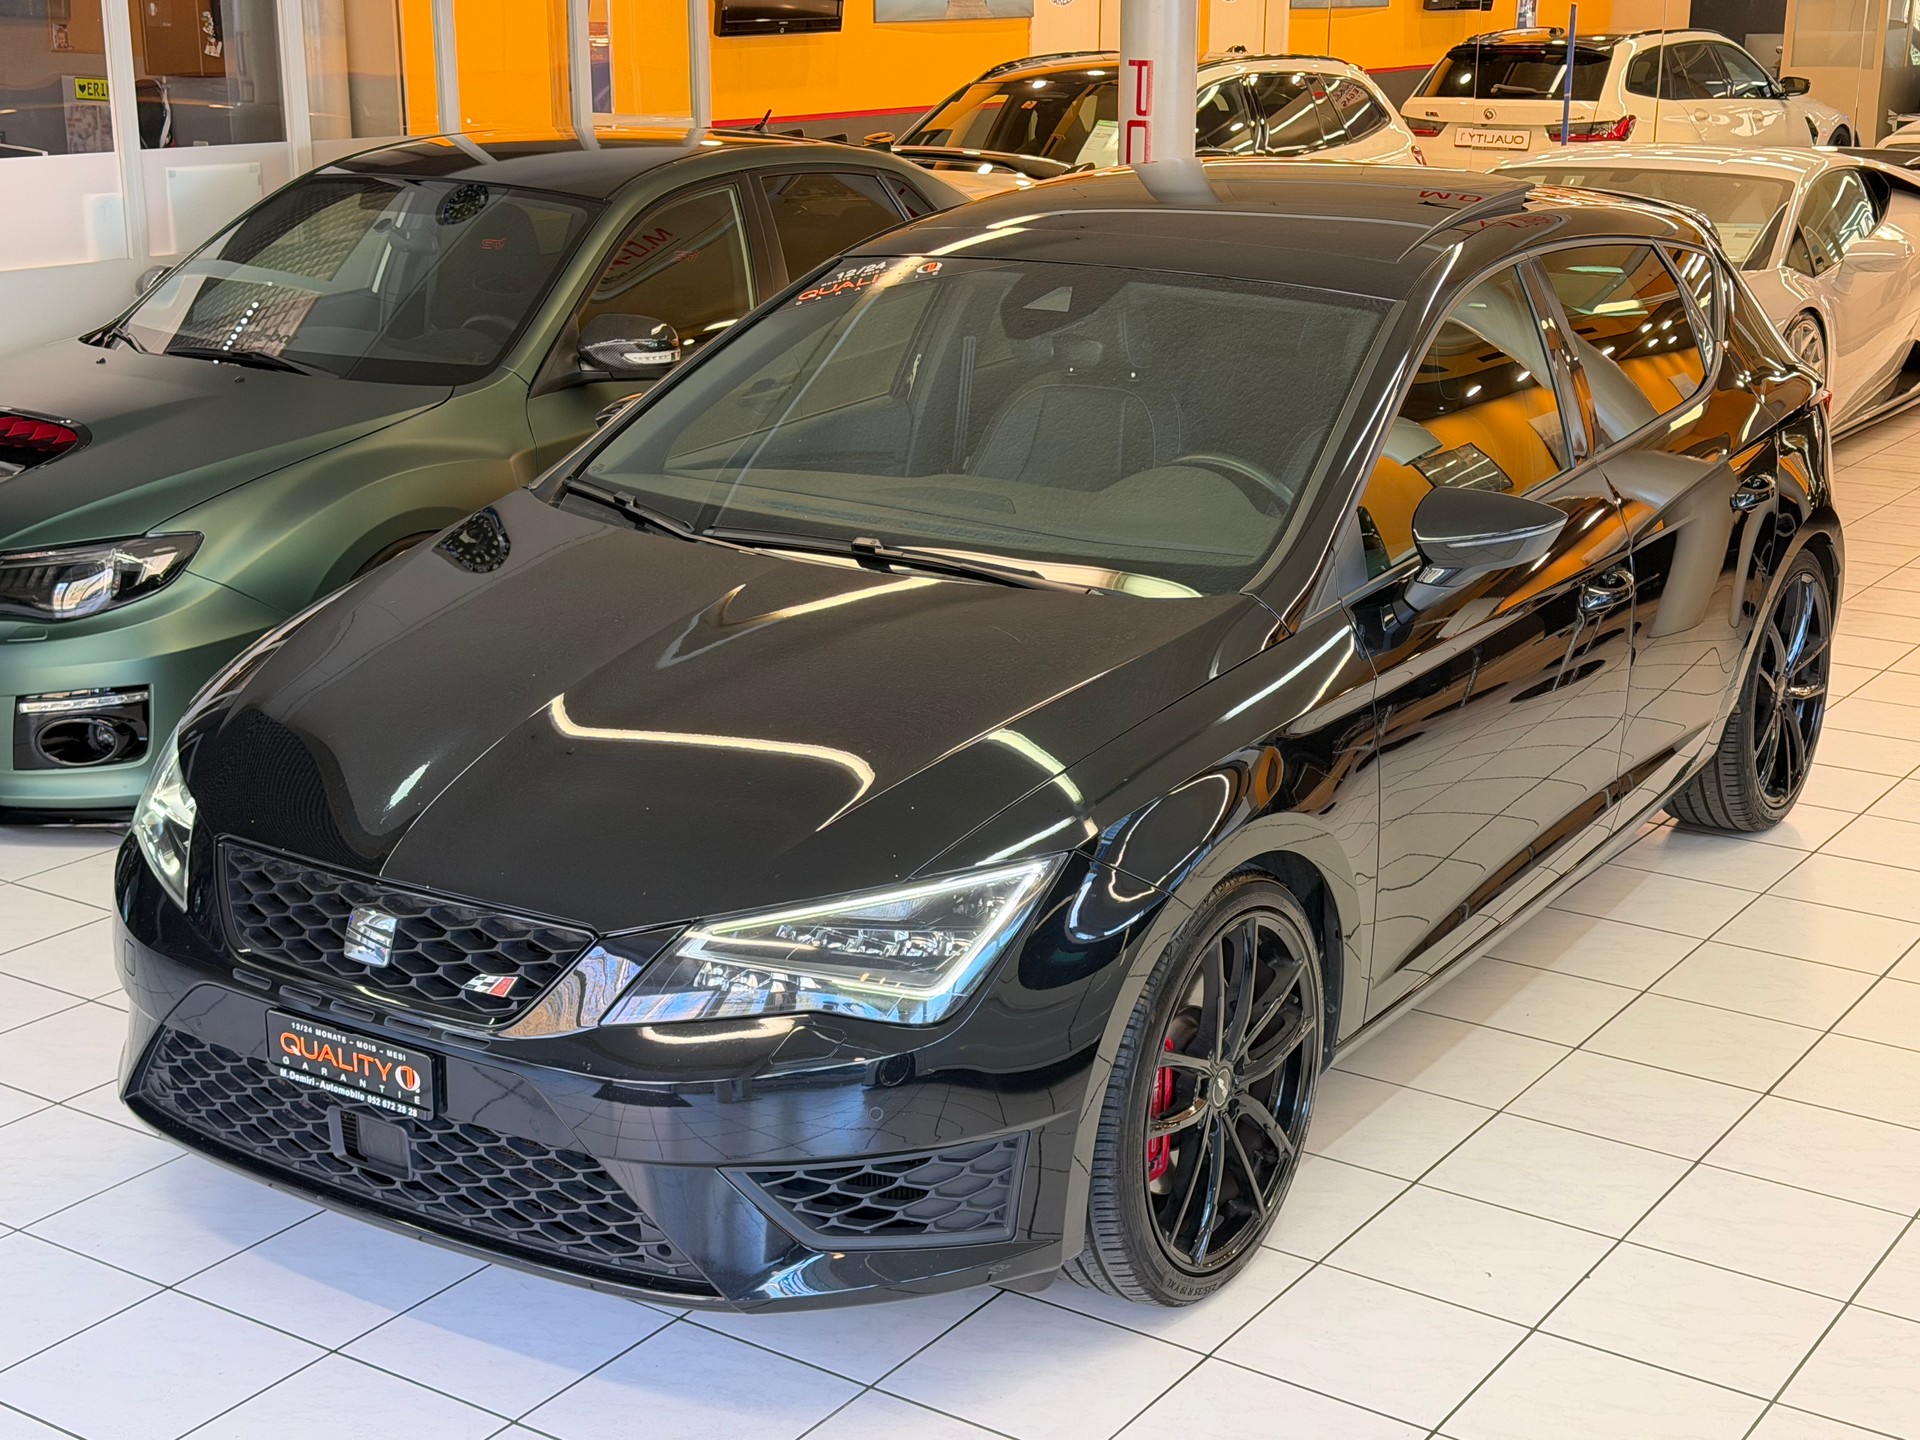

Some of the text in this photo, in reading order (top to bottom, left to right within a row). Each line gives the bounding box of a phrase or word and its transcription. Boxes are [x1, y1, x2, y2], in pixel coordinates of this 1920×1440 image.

[86, 82, 109, 97] ERI
[836, 261, 887, 280] 12/24
[798, 272, 889, 300] QUALI
[291, 1022, 313, 1034] 12/24
[315, 1028, 347, 1044] MONATE
[356, 1040, 377, 1053] MOIS
[386, 1049, 406, 1062] MESI
[280, 1032, 393, 1082] QUALITY
[367, 1094, 381, 1107] 052
[382, 1097, 396, 1112] 672
[397, 1102, 407, 1115] 28
[408, 1106, 418, 1118] 28
